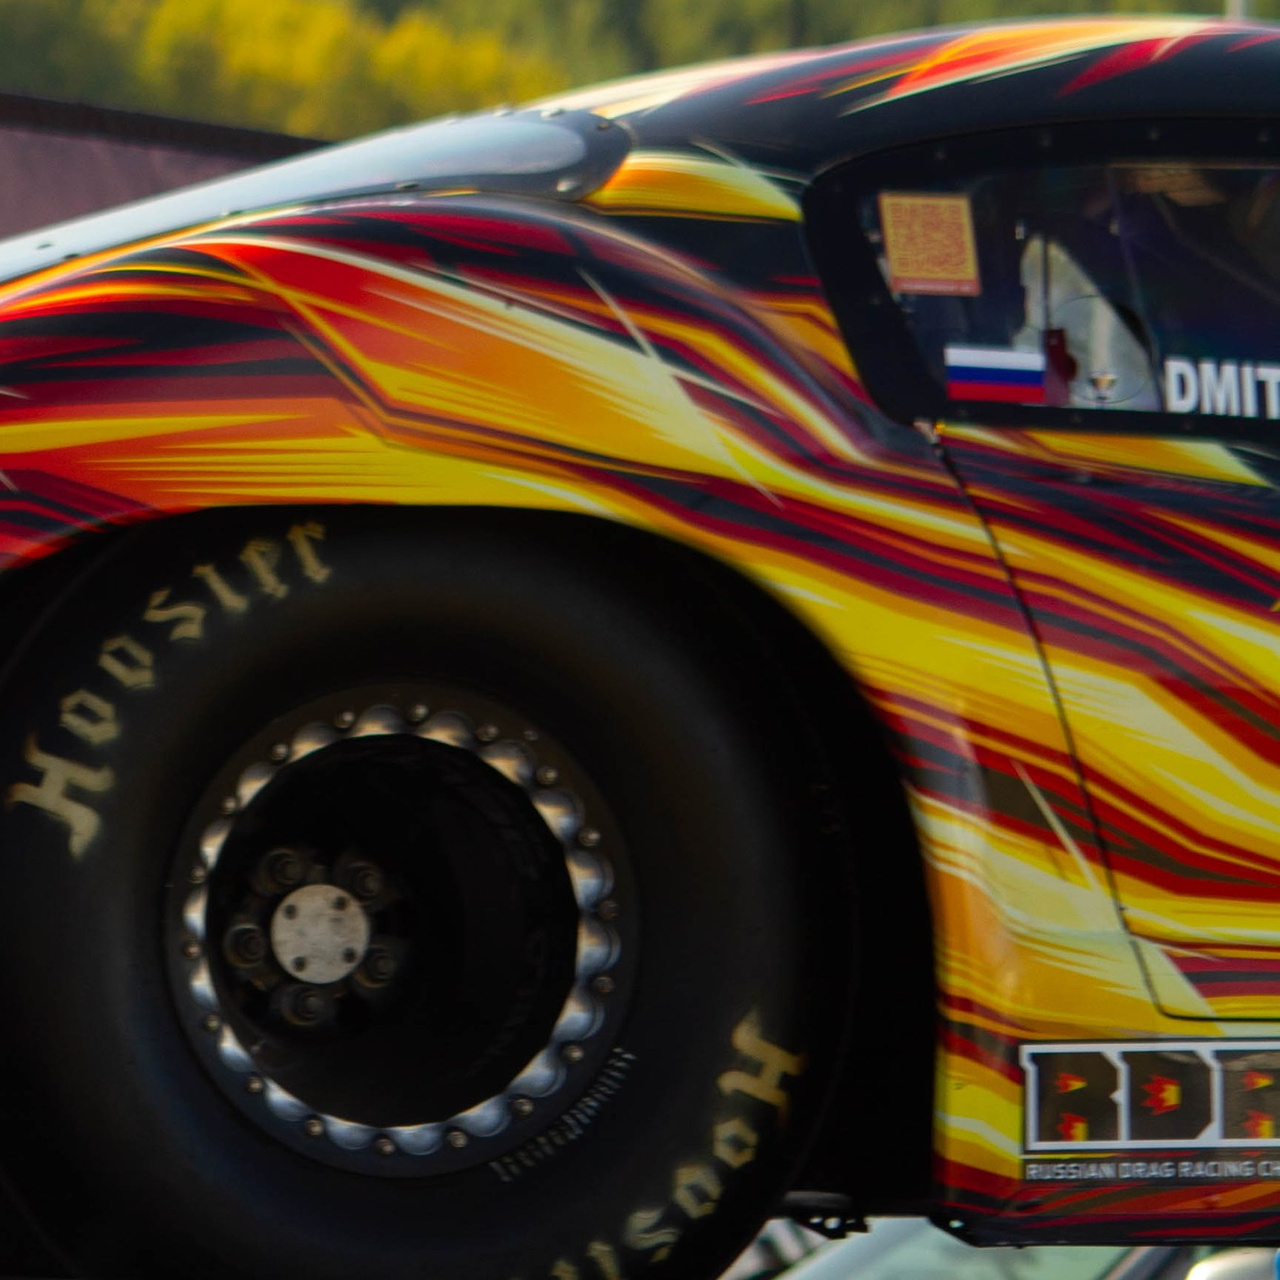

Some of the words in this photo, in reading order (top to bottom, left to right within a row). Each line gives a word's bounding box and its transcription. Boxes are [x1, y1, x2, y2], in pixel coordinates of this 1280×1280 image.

[1163, 358, 1280, 420] DMIT
[4, 521, 334, 860] Hoosier
[1025, 1162, 1116, 1180] RUSSIAN
[1118, 1161, 1176, 1179] DRAG
[1177, 1160, 1255, 1178] RACING
